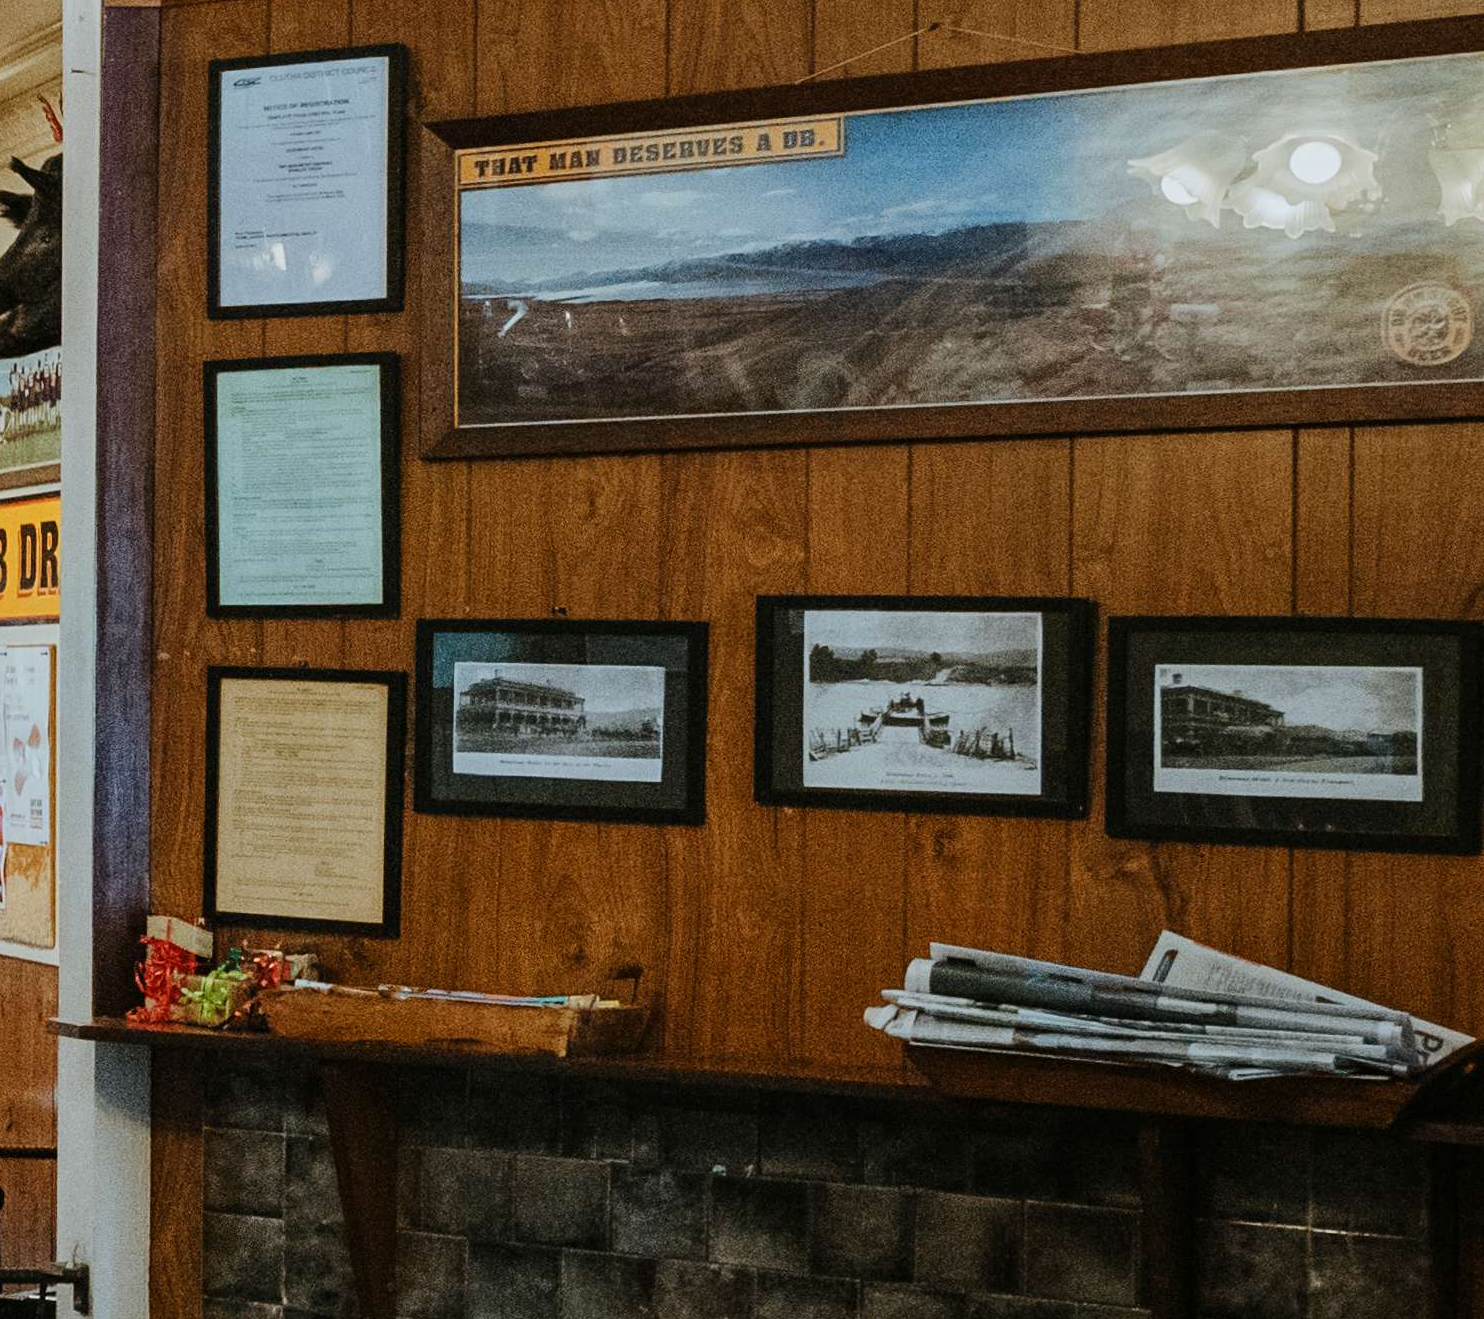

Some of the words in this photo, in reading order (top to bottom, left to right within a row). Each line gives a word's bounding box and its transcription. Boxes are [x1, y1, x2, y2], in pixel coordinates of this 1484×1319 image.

[474, 154, 538, 178] THAT
[548, 149, 601, 171] MAN
[613, 134, 744, 165] DESERVES
[756, 132, 773, 152] A
[783, 128, 826, 150] DB.
